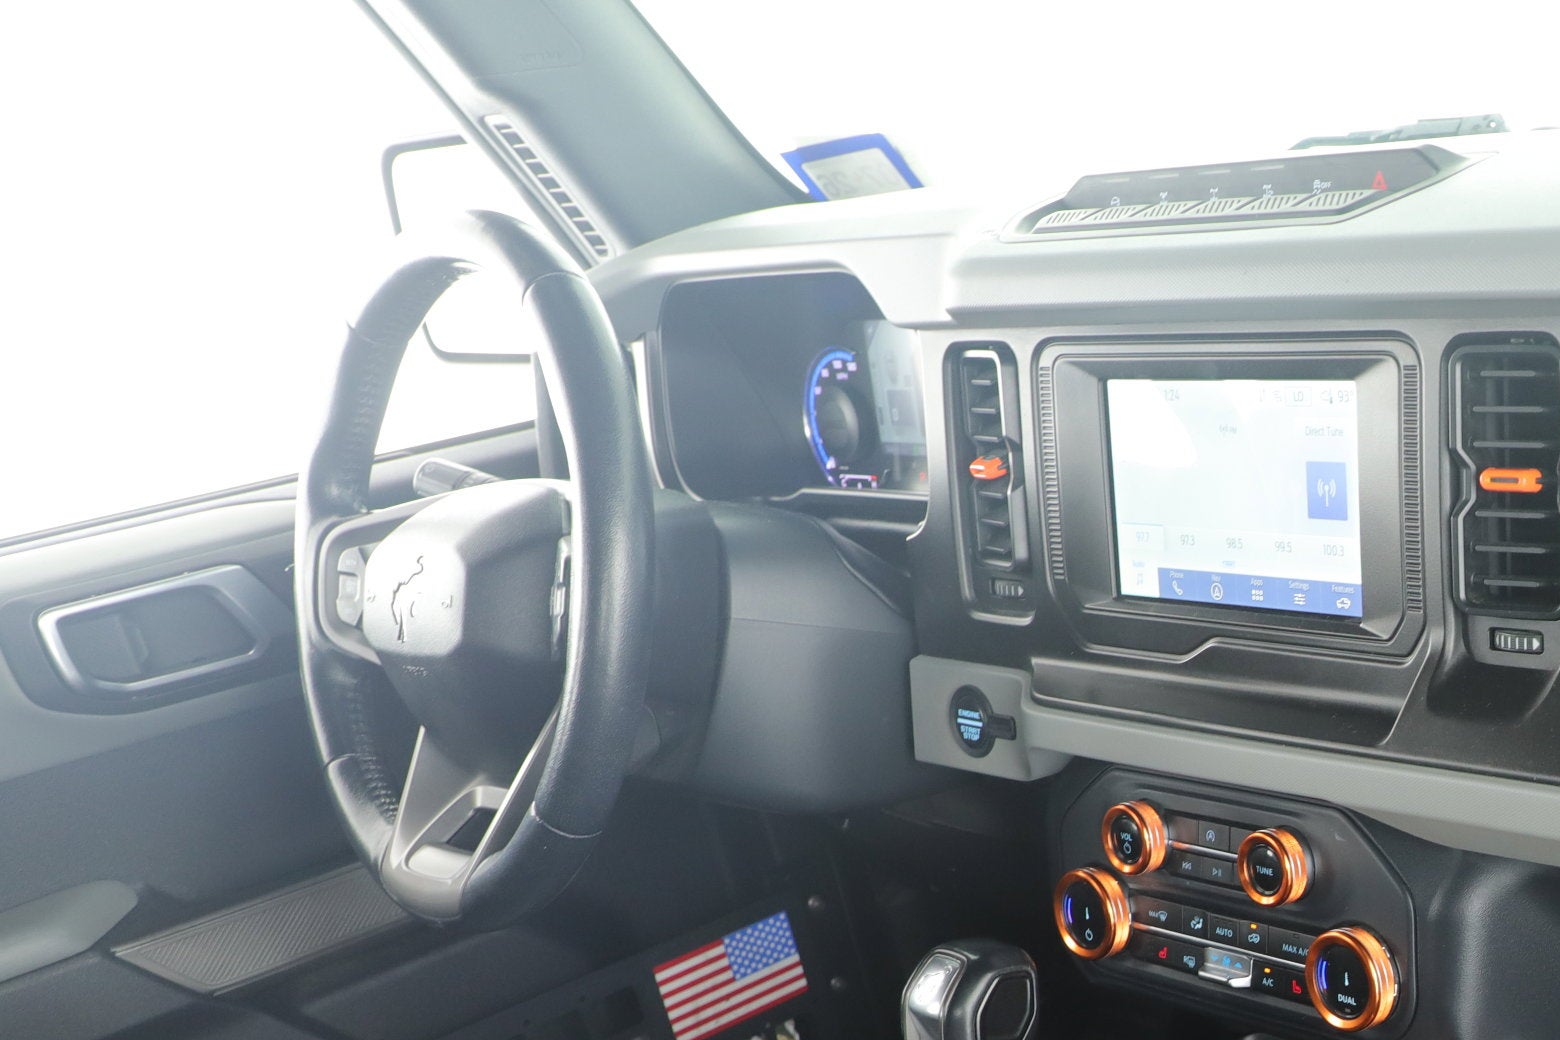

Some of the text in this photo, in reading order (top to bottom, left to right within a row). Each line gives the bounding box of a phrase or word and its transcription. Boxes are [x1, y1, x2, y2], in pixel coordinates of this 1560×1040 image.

[958, 709, 980, 719] ENGINE
[961, 725, 980, 734] START
[963, 733, 980, 741] STOP
[1120, 832, 1132, 842] VOL
[1256, 865, 1274, 876] TUNE
[1216, 927, 1233, 938] AUTO
[1281, 943, 1298, 954] MAX
[1262, 977, 1275, 988] A/C
[1338, 994, 1356, 1005] DUAL
